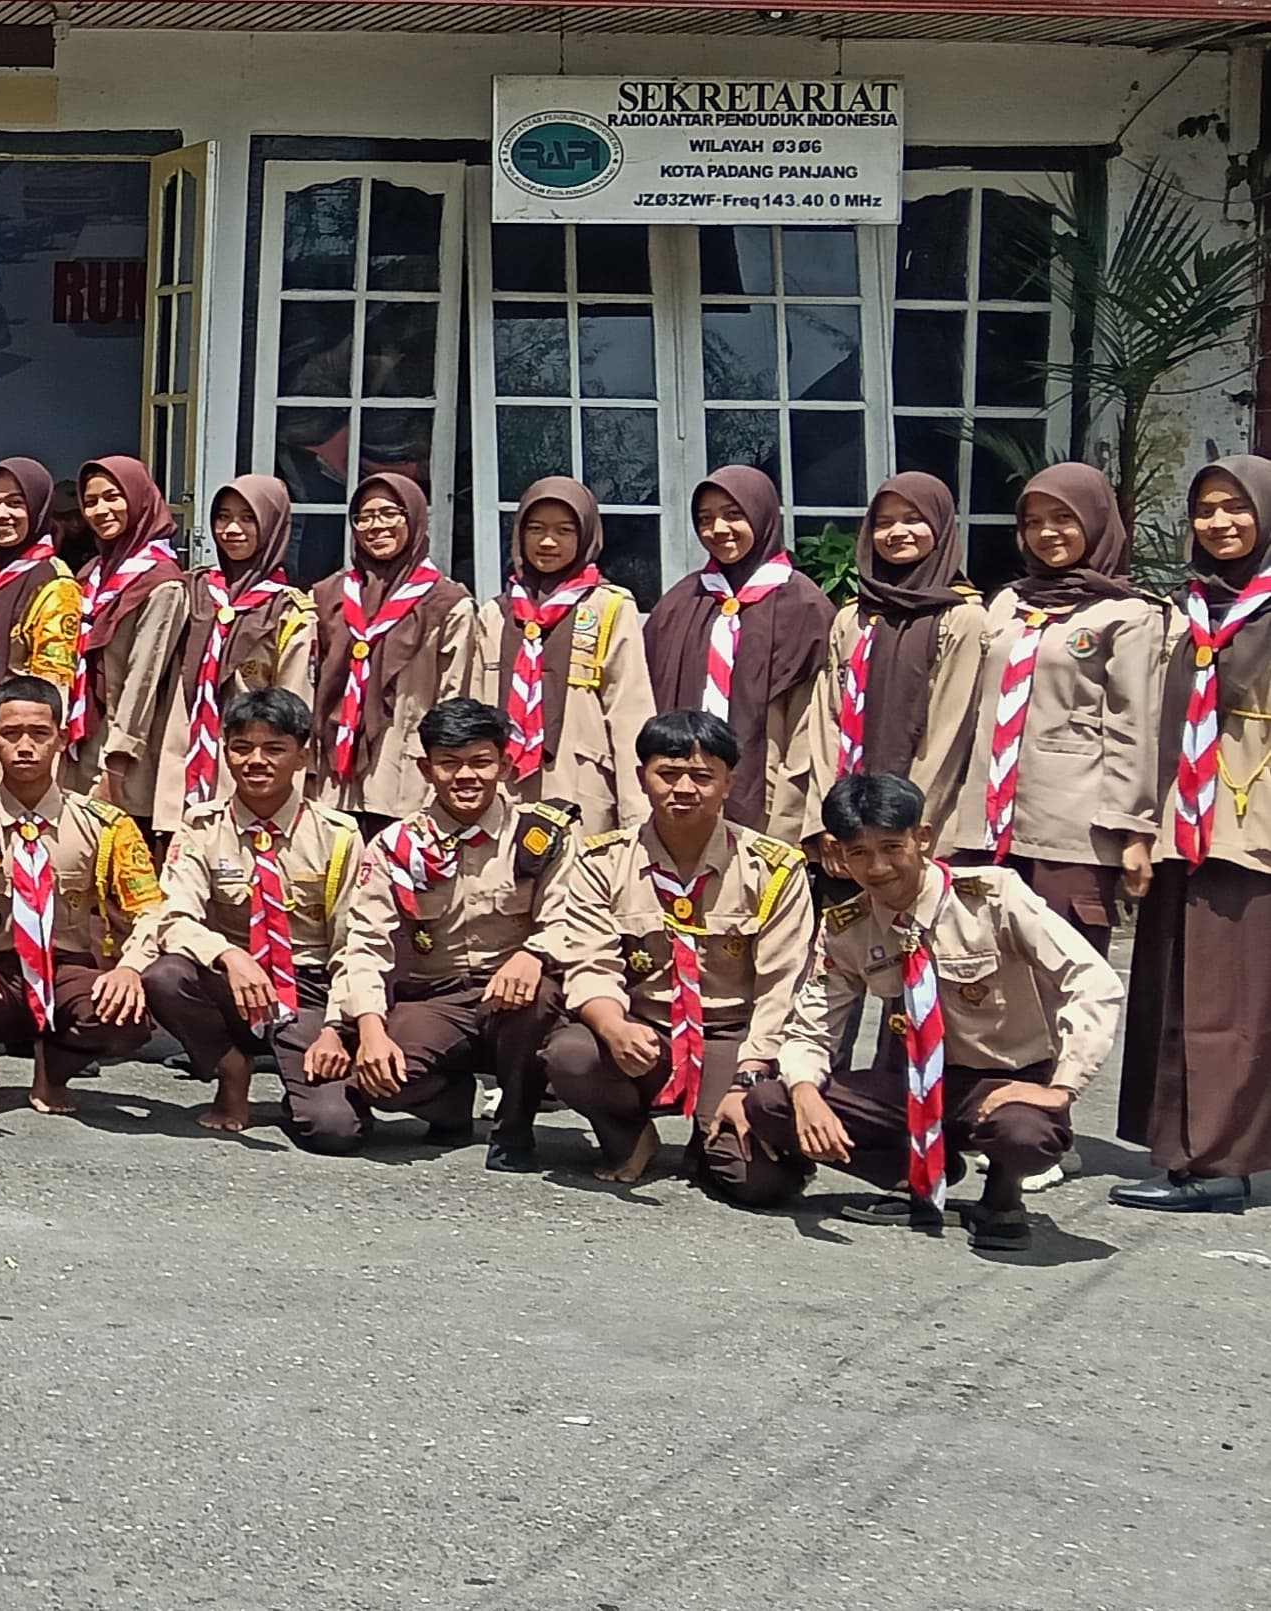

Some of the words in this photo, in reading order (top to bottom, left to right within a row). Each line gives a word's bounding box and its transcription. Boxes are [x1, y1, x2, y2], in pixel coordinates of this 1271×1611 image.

[618, 82, 898, 112] SEKRETARIAT
[608, 114, 662, 127] RADIO
[662, 114, 715, 127] ANTAR
[717, 114, 805, 127] PENDUDUK
[807, 114, 898, 127] INDONESIA
[689, 140, 764, 153] WILAYAH
[520, 140, 601, 171] RAPI
[660, 165, 704, 178] KOTA
[707, 165, 774, 178] PADANG
[779, 166, 858, 178] PANJANG
[845, 195, 882, 207] MHz
